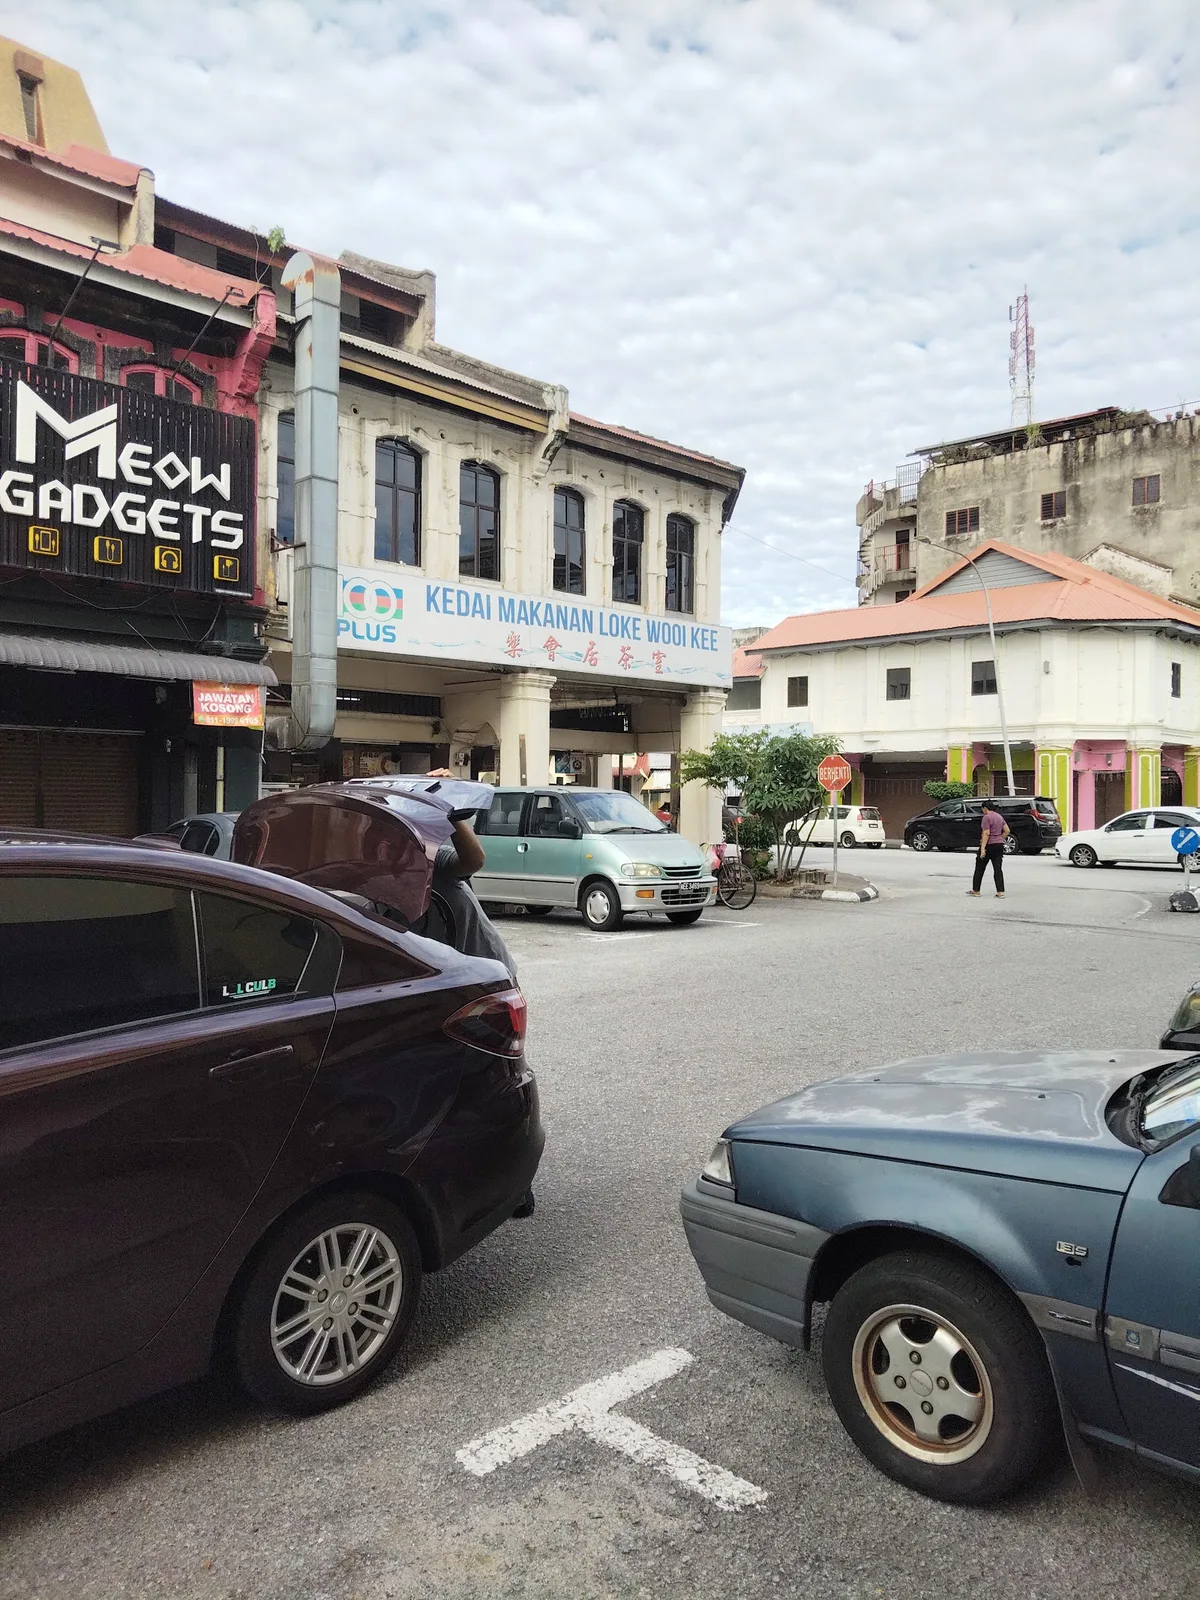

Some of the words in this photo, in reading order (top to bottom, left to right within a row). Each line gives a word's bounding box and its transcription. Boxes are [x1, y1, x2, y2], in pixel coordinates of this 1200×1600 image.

[16, 380, 231, 501] MEOW
[0, 470, 244, 550] GADGETS
[426, 584, 491, 620] KEDAI
[498, 596, 594, 634] MAKANAN
[599, 611, 642, 641] LOKE
[646, 619, 686, 648] WOOI
[690, 627, 719, 652] KEE
[336, 619, 396, 643] PLUS
[197, 692, 255, 704] JAWATAN
[200, 702, 252, 713] KOSONG
[819, 766, 850, 780] BERHENTI
[245, 978, 276, 993] CULB
